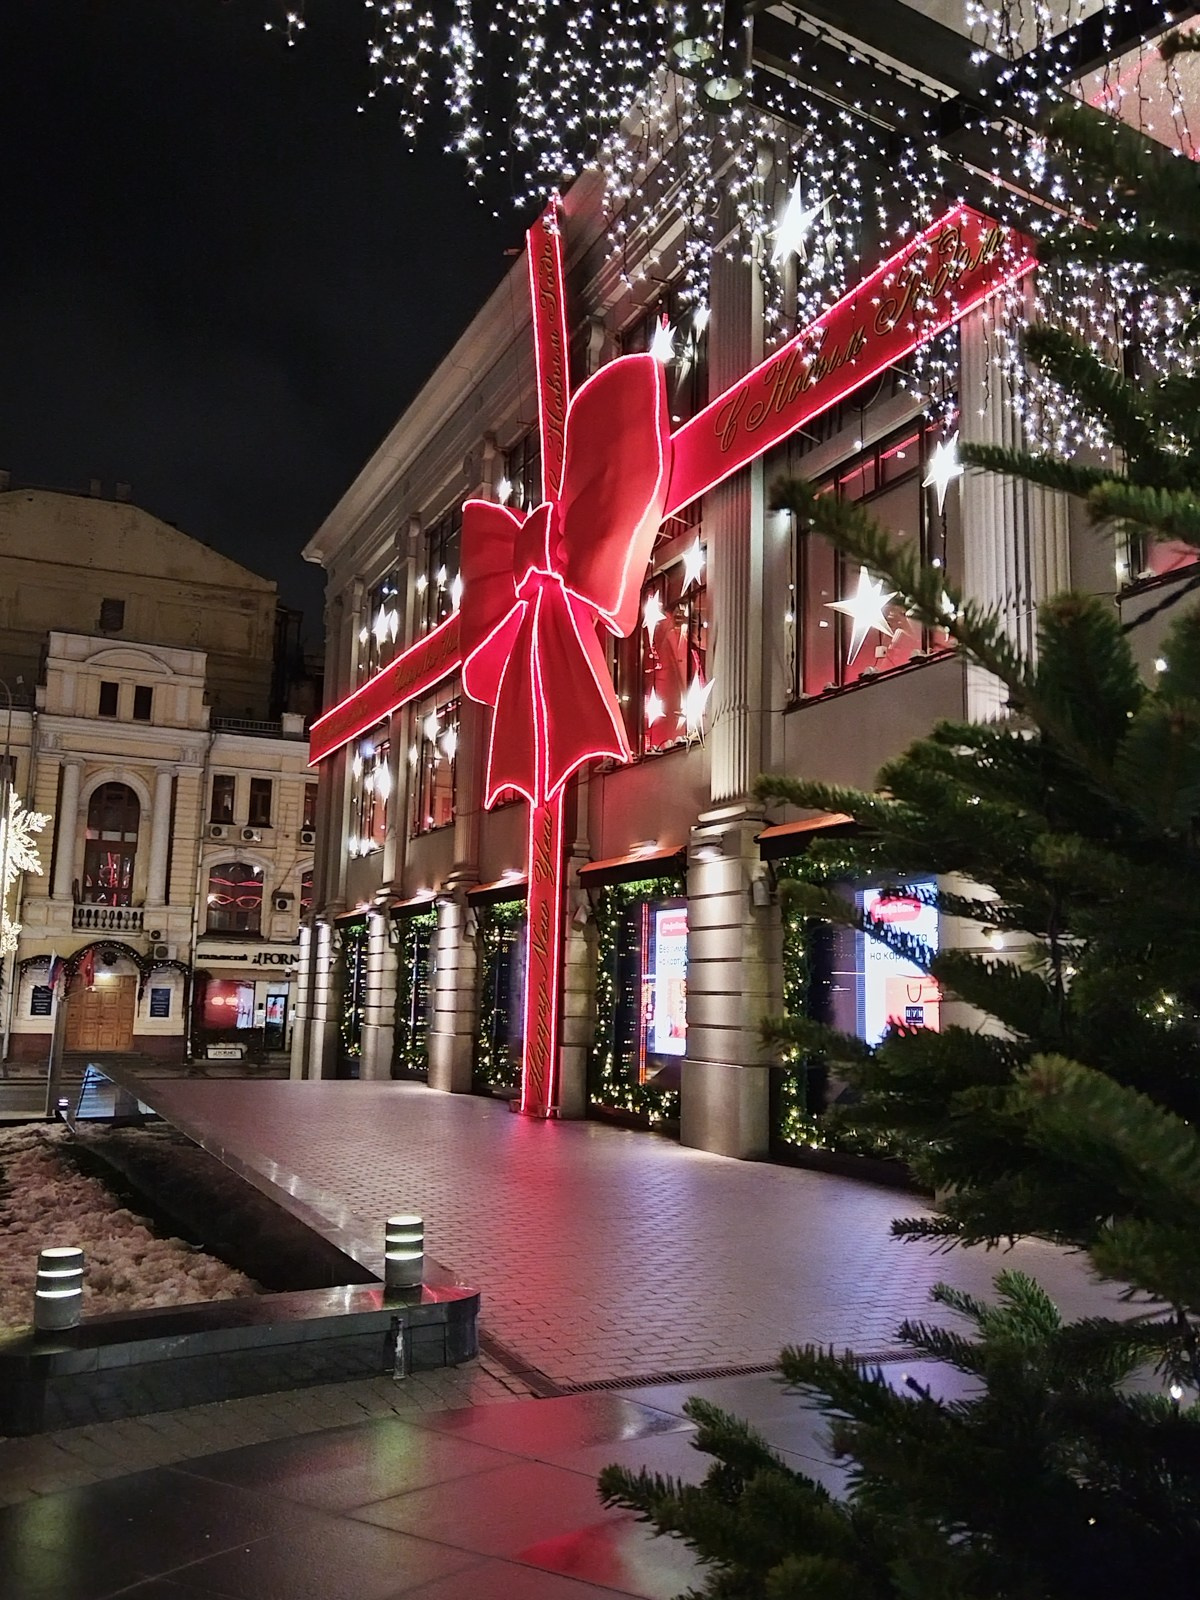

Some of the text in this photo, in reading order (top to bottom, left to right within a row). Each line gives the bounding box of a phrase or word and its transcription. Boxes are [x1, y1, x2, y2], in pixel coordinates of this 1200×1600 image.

[545, 329, 564, 464] Новым
[713, 227, 1005, 452] С Новым Годом
[527, 806, 555, 1102] Happy New Year
[870, 951, 882, 960] на
